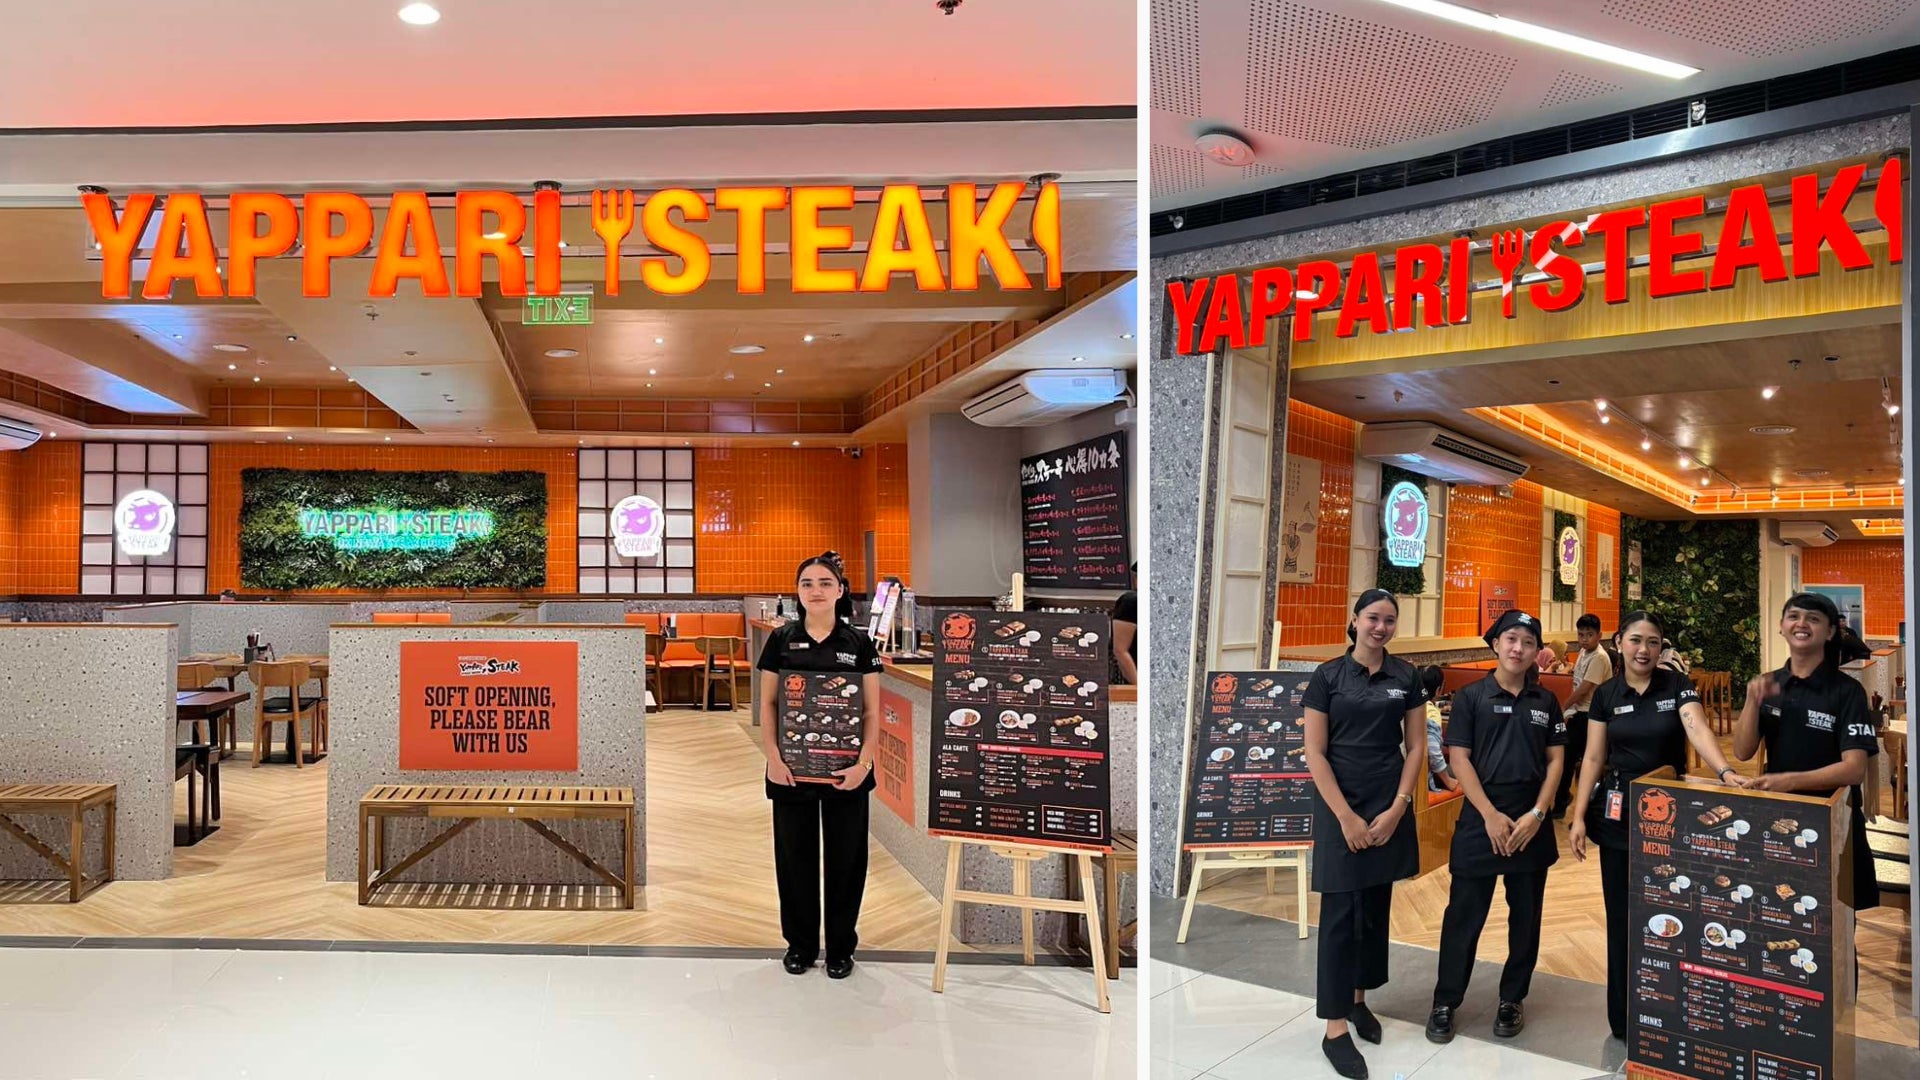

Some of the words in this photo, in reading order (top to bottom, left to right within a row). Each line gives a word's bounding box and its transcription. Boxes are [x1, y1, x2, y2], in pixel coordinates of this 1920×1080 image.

[80, 190, 562, 299] YAPPARI
[640, 182, 1033, 294] STEAK
[1168, 237, 1469, 355] YAPPARI
[1528, 162, 1873, 312] STEAK
[303, 513, 396, 535] YAPPARI
[412, 513, 481, 535] STEAK
[1393, 538, 1420, 550] YAPPARI
[1394, 549, 1416, 560] STEAK
[944, 654, 970, 664] MENU
[424, 686, 469, 707] SOFT
[475, 686, 556, 708] OPENING,
[430, 710, 498, 730] PLEASE
[504, 710, 551, 730] BEAR
[1812, 718, 1832, 728] STEAK
[452, 732, 500, 754] WITH
[506, 732, 528, 754] US
[940, 790, 961, 798] DRINKS
[1642, 840, 1671, 857] MENU
[1691, 838, 1717, 848] YAPPARI
[1718, 840, 1736, 850] STEAK
[1653, 959, 1671, 970] CARTE
[1640, 1014, 1662, 1028] DRINKS
